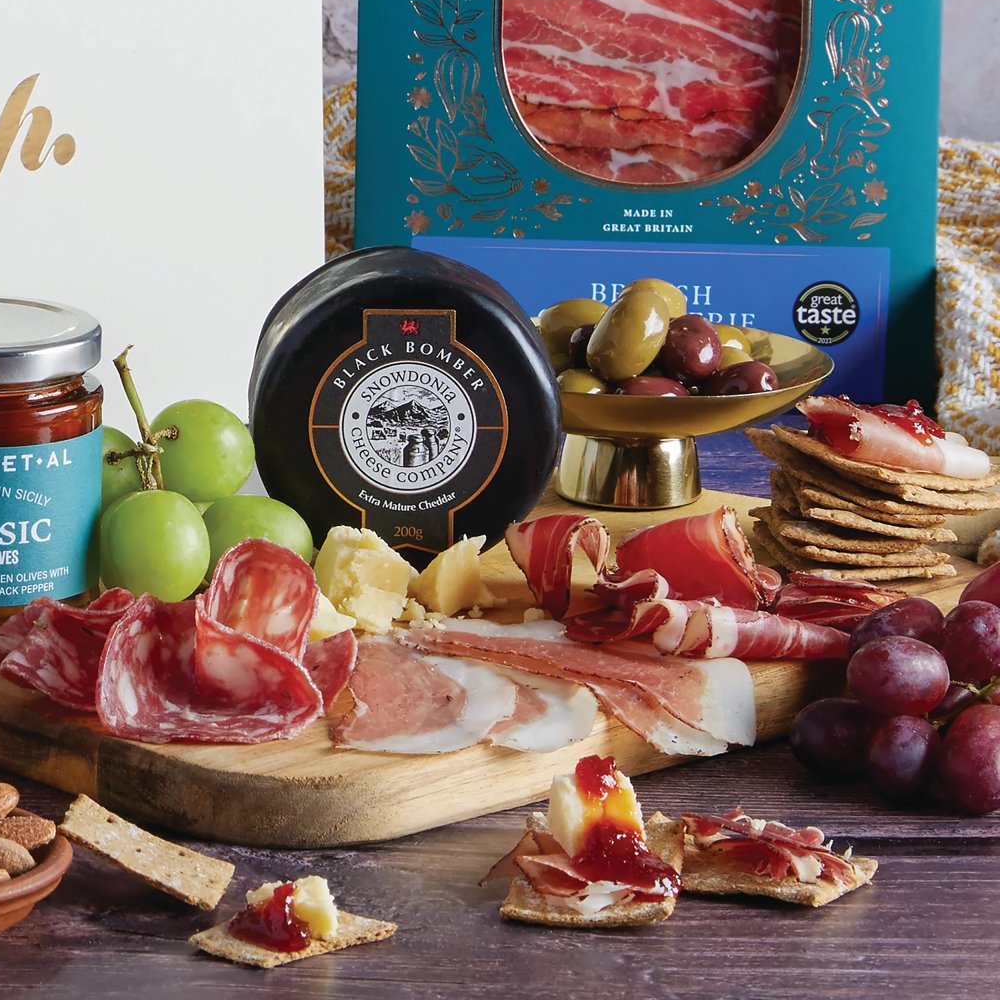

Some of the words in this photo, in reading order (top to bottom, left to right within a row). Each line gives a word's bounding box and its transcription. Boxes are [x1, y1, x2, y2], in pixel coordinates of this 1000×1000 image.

[623, 209, 656, 218] MADE
[660, 209, 673, 218] IN
[602, 223, 641, 232] GREAT
[644, 224, 693, 233] BRITAIN
[810, 294, 843, 308] great
[796, 305, 857, 325] taste
[333, 343, 392, 389] BLACK
[405, 341, 485, 391] BOMBER
[14, 488, 52, 508] SICILY
[358, 489, 381, 506] Extra
[382, 500, 417, 512] Mature
[418, 491, 457, 511] Cheddar
[393, 526, 424, 541] 200g
[16, 570, 48, 582] OLIVES
[49, 566, 70, 578] WITH
[21, 581, 54, 594] PEPPER
